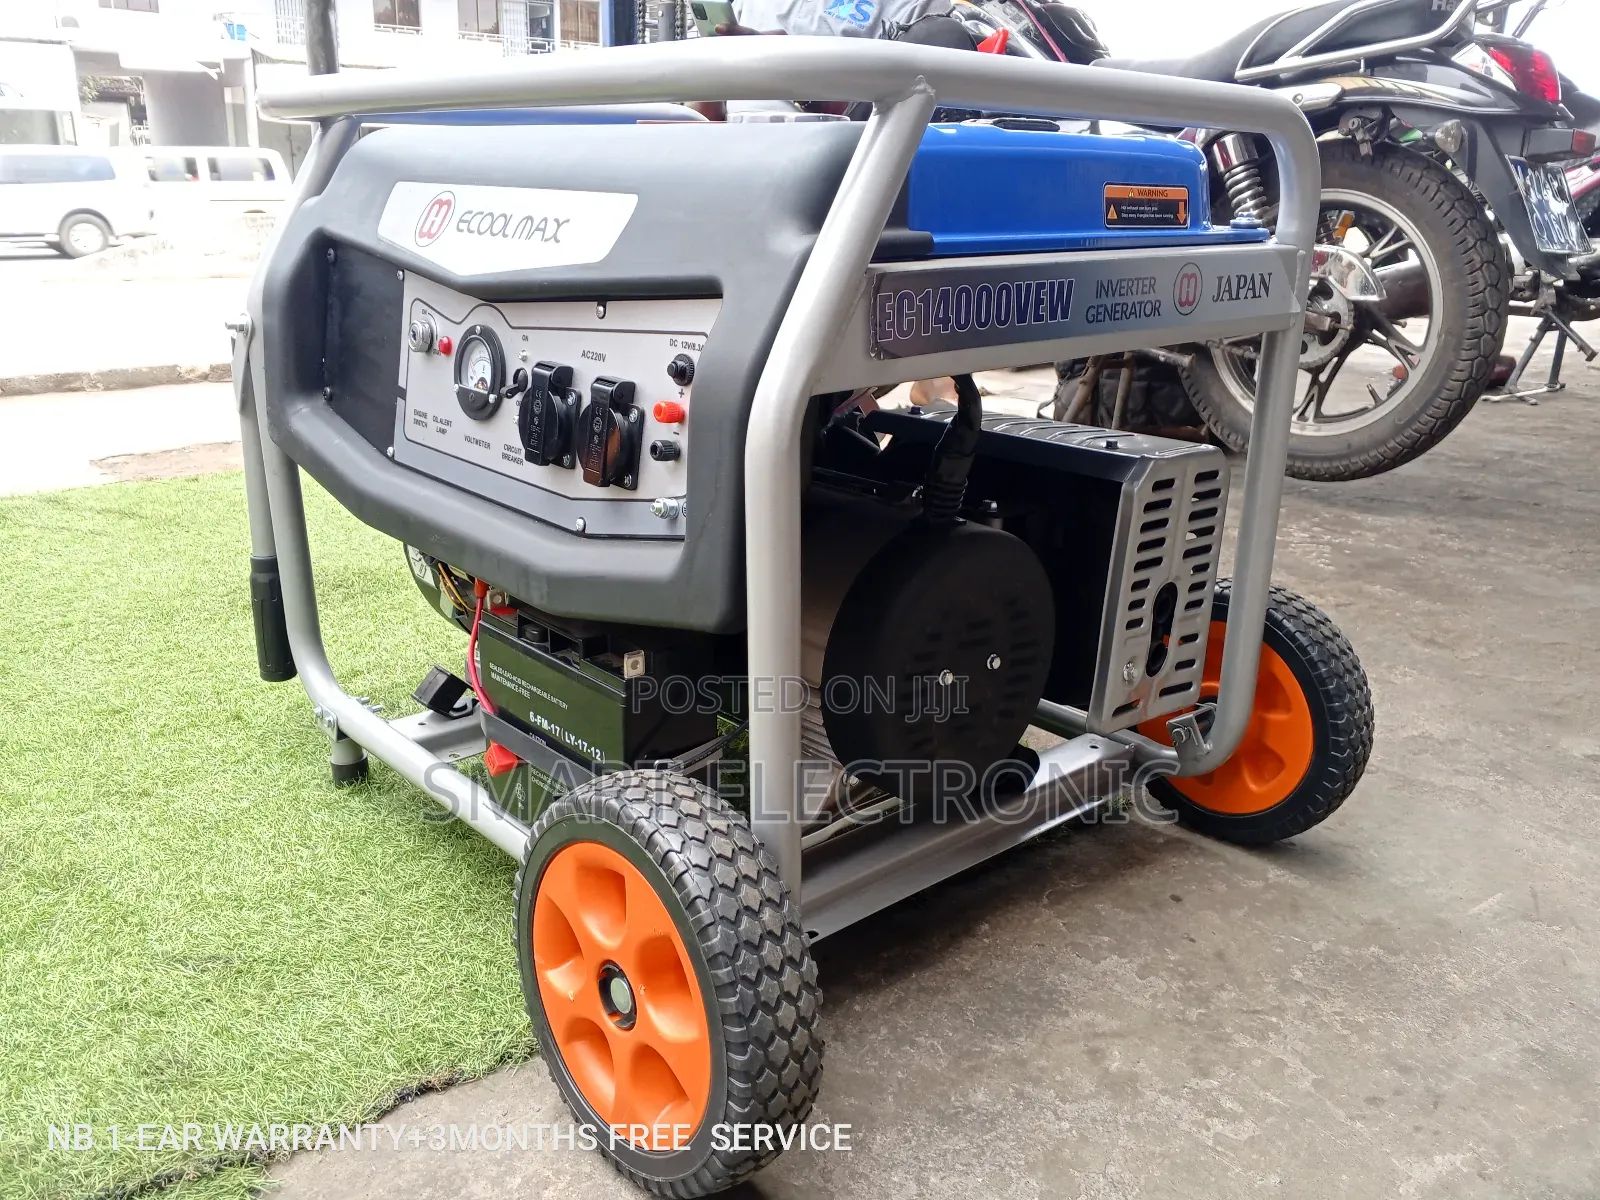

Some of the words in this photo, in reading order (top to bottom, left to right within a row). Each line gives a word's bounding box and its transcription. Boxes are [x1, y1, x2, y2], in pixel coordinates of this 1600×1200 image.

[1137, 189, 1169, 198] WARNING
[456, 210, 570, 243] ECOOLMAX
[1095, 277, 1157, 299] INVERTER
[1212, 272, 1273, 303] JAPAN
[876, 278, 1075, 343] EC14000VEW
[1085, 299, 1162, 324] GENERATOR
[522, 334, 529, 342] ON
[669, 338, 678, 348] DC
[581, 349, 607, 363] AC220V
[413, 408, 428, 420] ENGINE
[413, 417, 428, 429] SWITCH
[436, 426, 448, 435] LAMP
[464, 434, 491, 450] VOLTMETER
[503, 443, 522, 455] CIRCUIT
[501, 451, 524, 466] BREAKER
[550, 695, 568, 710] BATTERY
